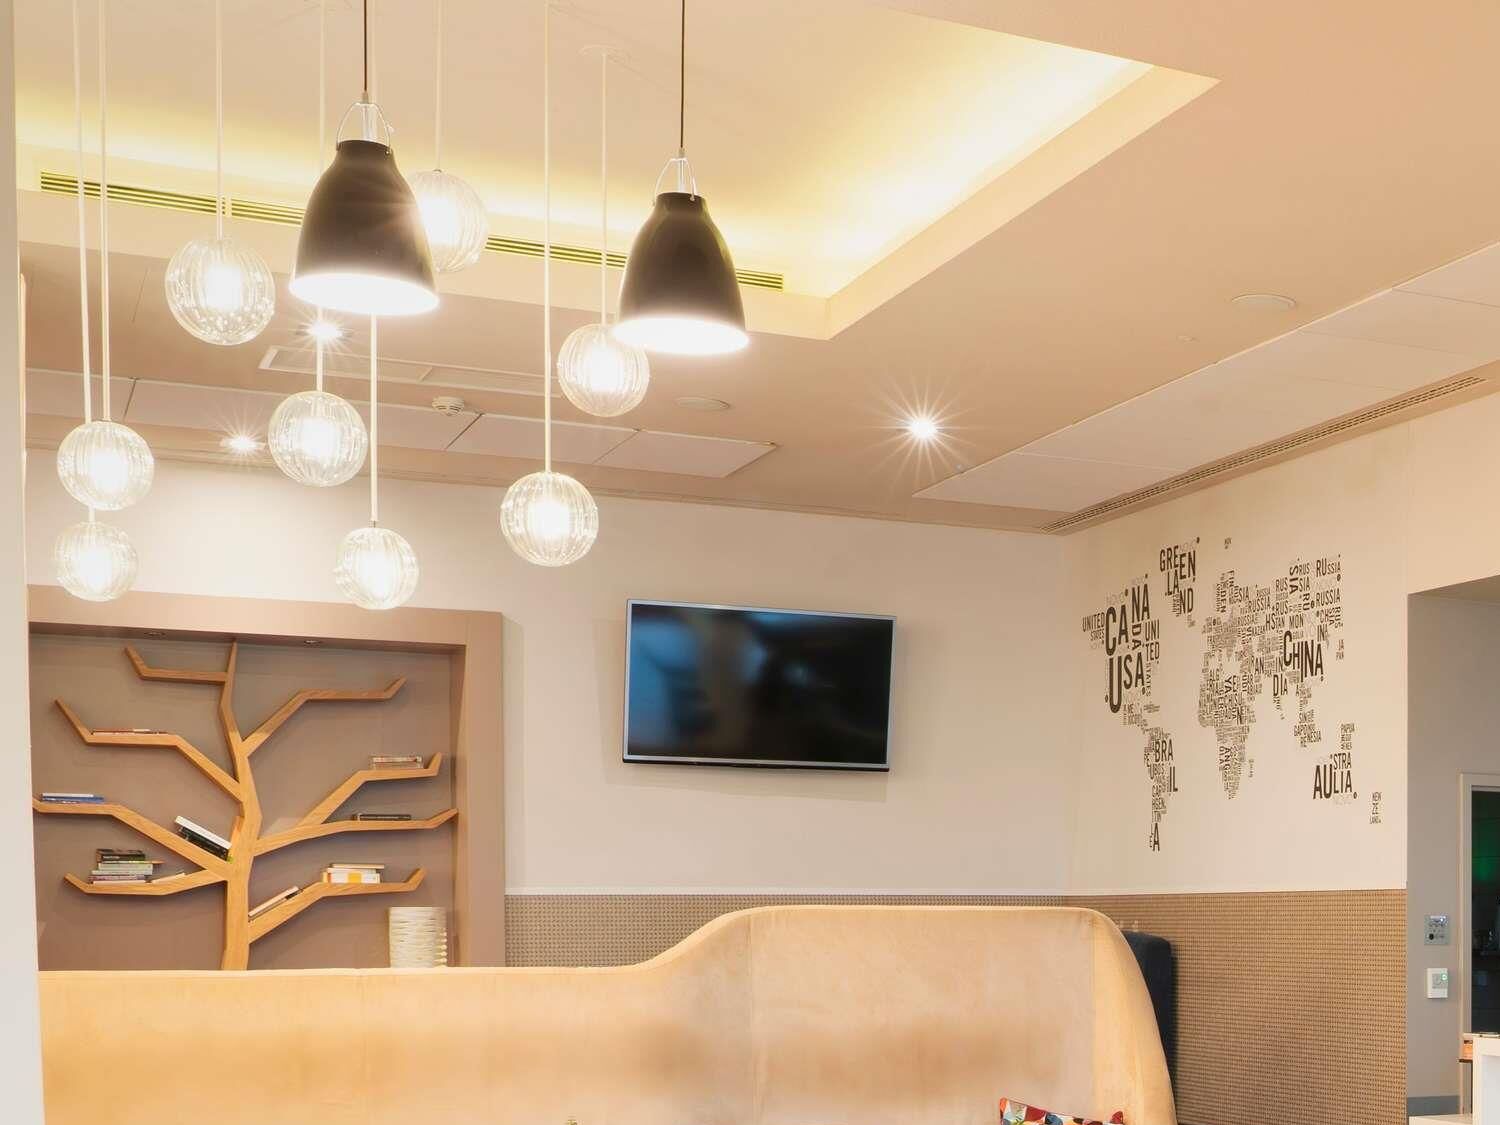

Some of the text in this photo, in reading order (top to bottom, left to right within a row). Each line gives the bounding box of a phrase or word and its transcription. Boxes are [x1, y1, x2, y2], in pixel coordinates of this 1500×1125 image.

[1316, 558, 1340, 577] RUSSIA
[1316, 588, 1340, 609] RUSSIA
[1083, 612, 1105, 632] UNITED
[1284, 630, 1324, 683] CHINA
[1109, 652, 1145, 713] USA
[1155, 739, 1173, 762] BRA
